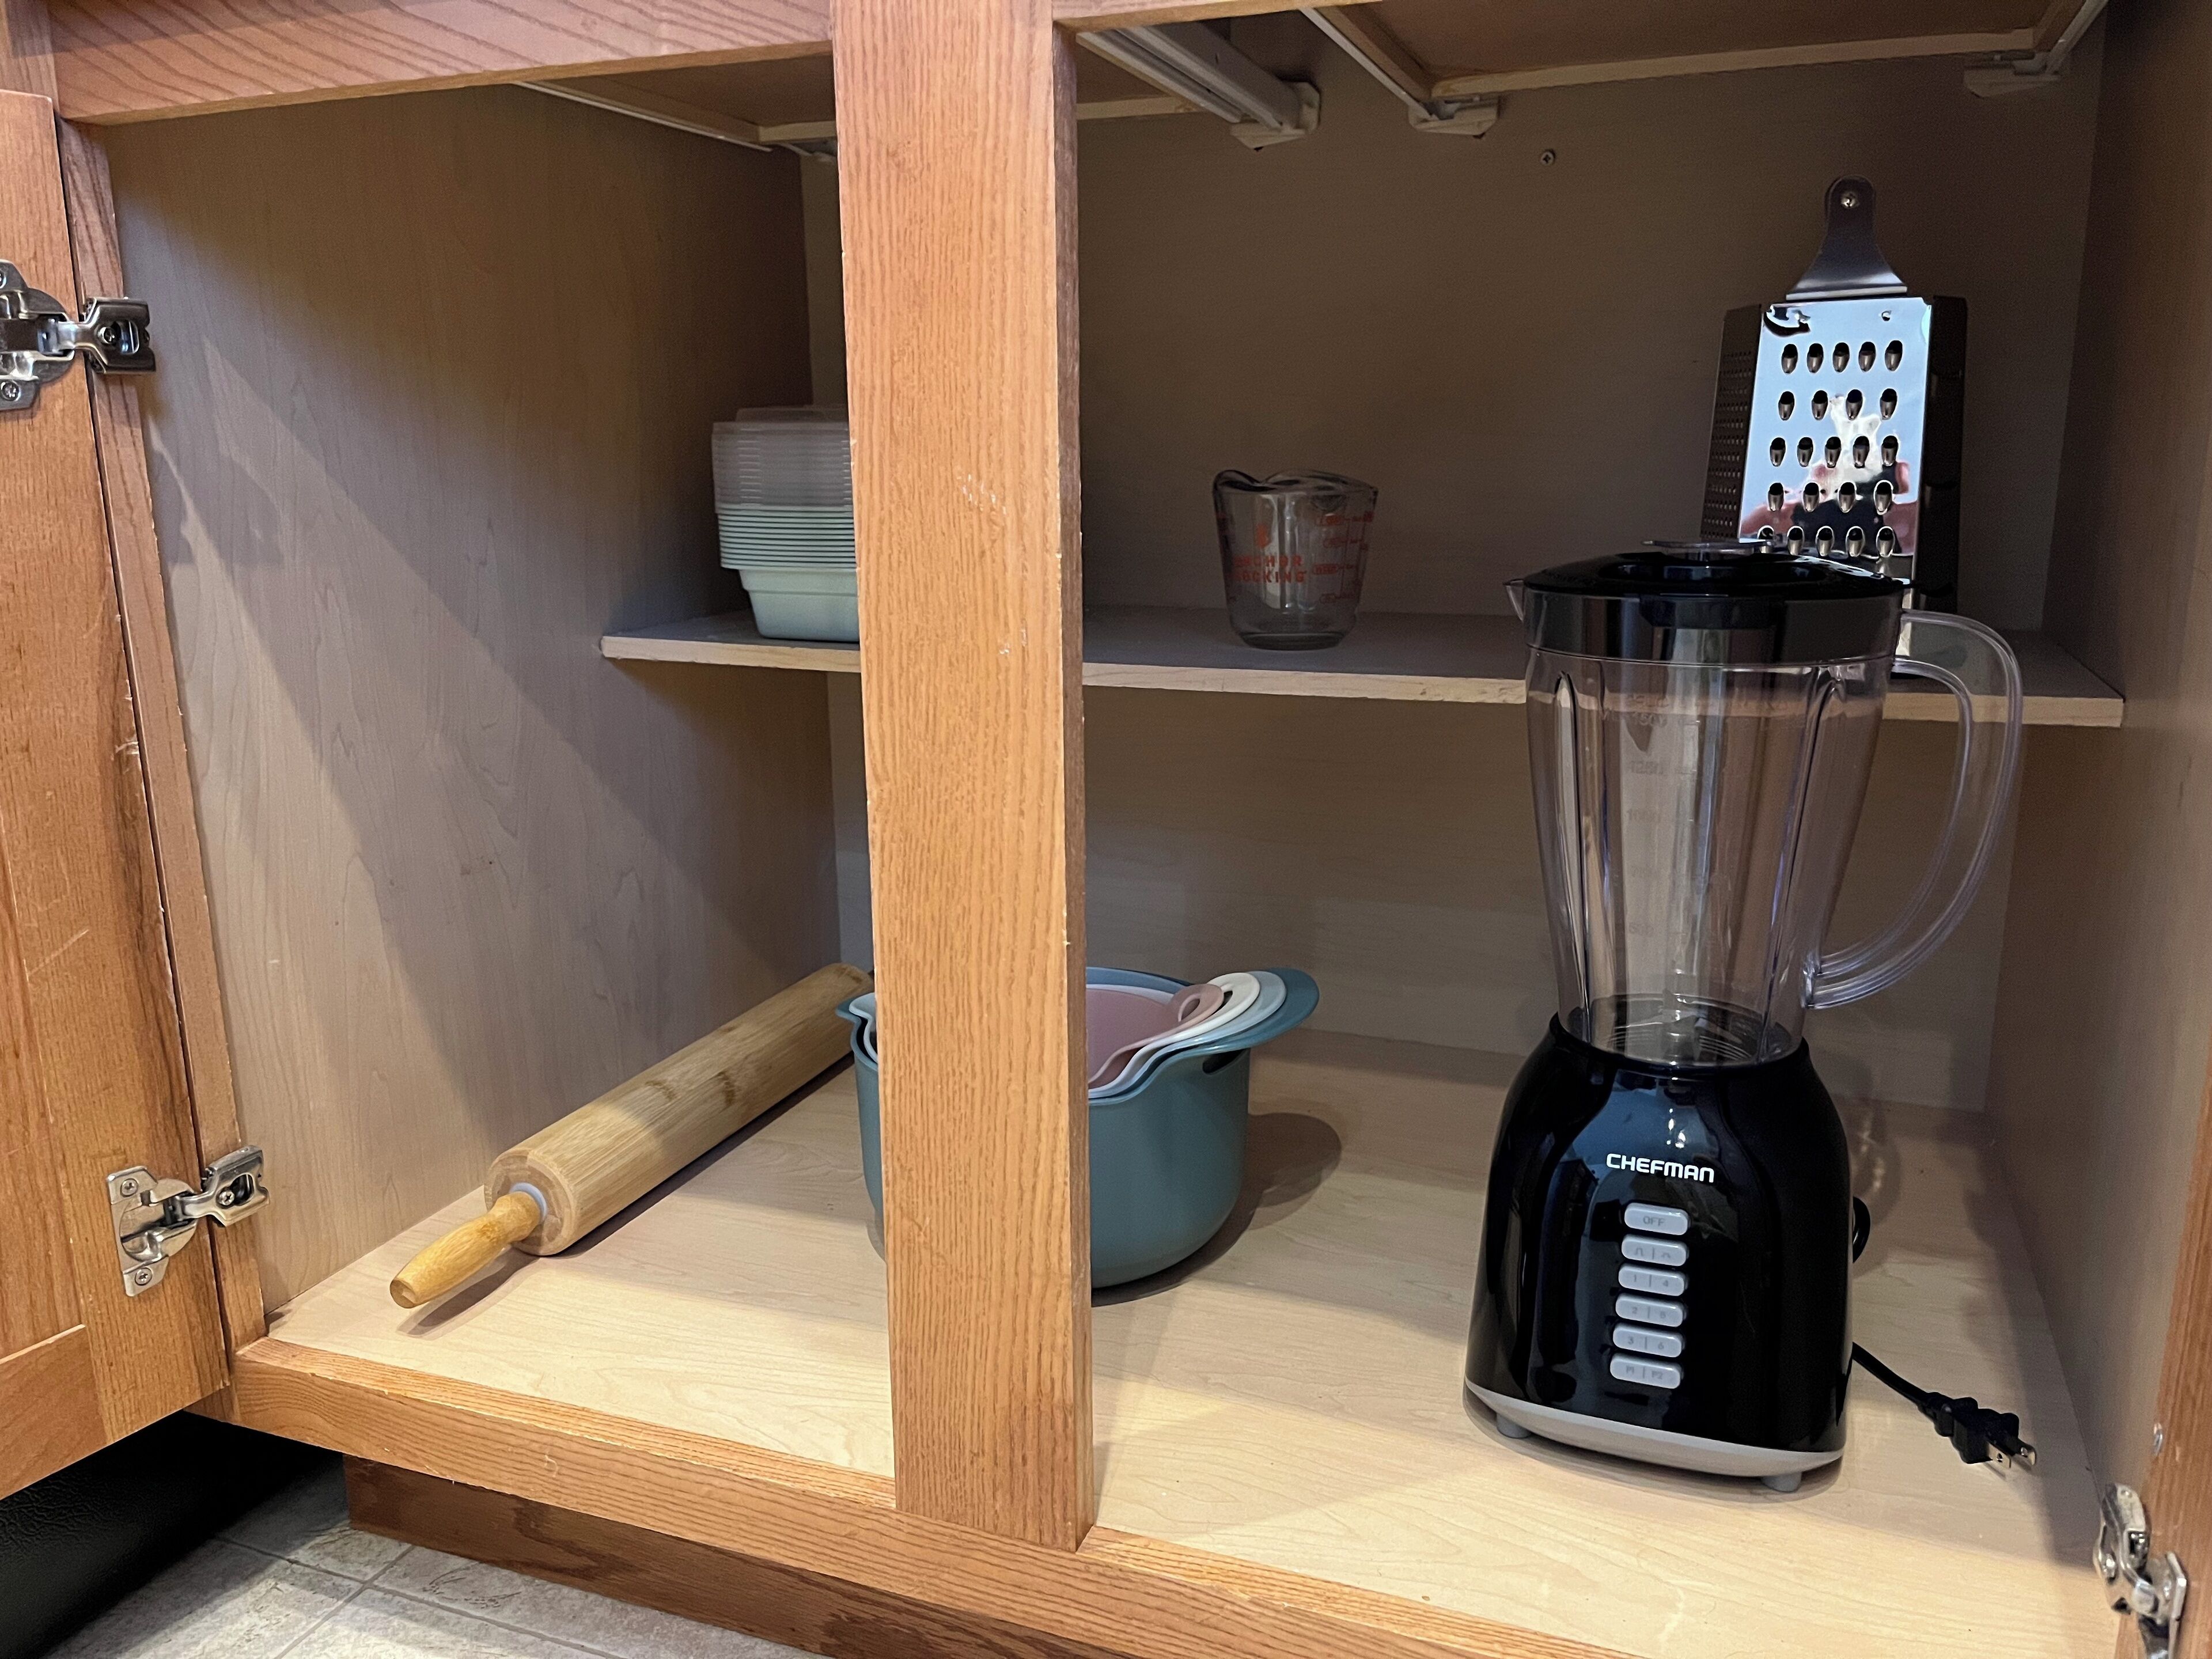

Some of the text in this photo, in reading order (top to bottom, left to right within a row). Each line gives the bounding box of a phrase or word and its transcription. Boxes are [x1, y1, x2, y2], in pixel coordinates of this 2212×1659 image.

[1606, 1153, 1714, 1183] CHEFMAN
[1643, 1215, 1665, 1226] OFF
[1628, 1336, 1634, 1345] 3
